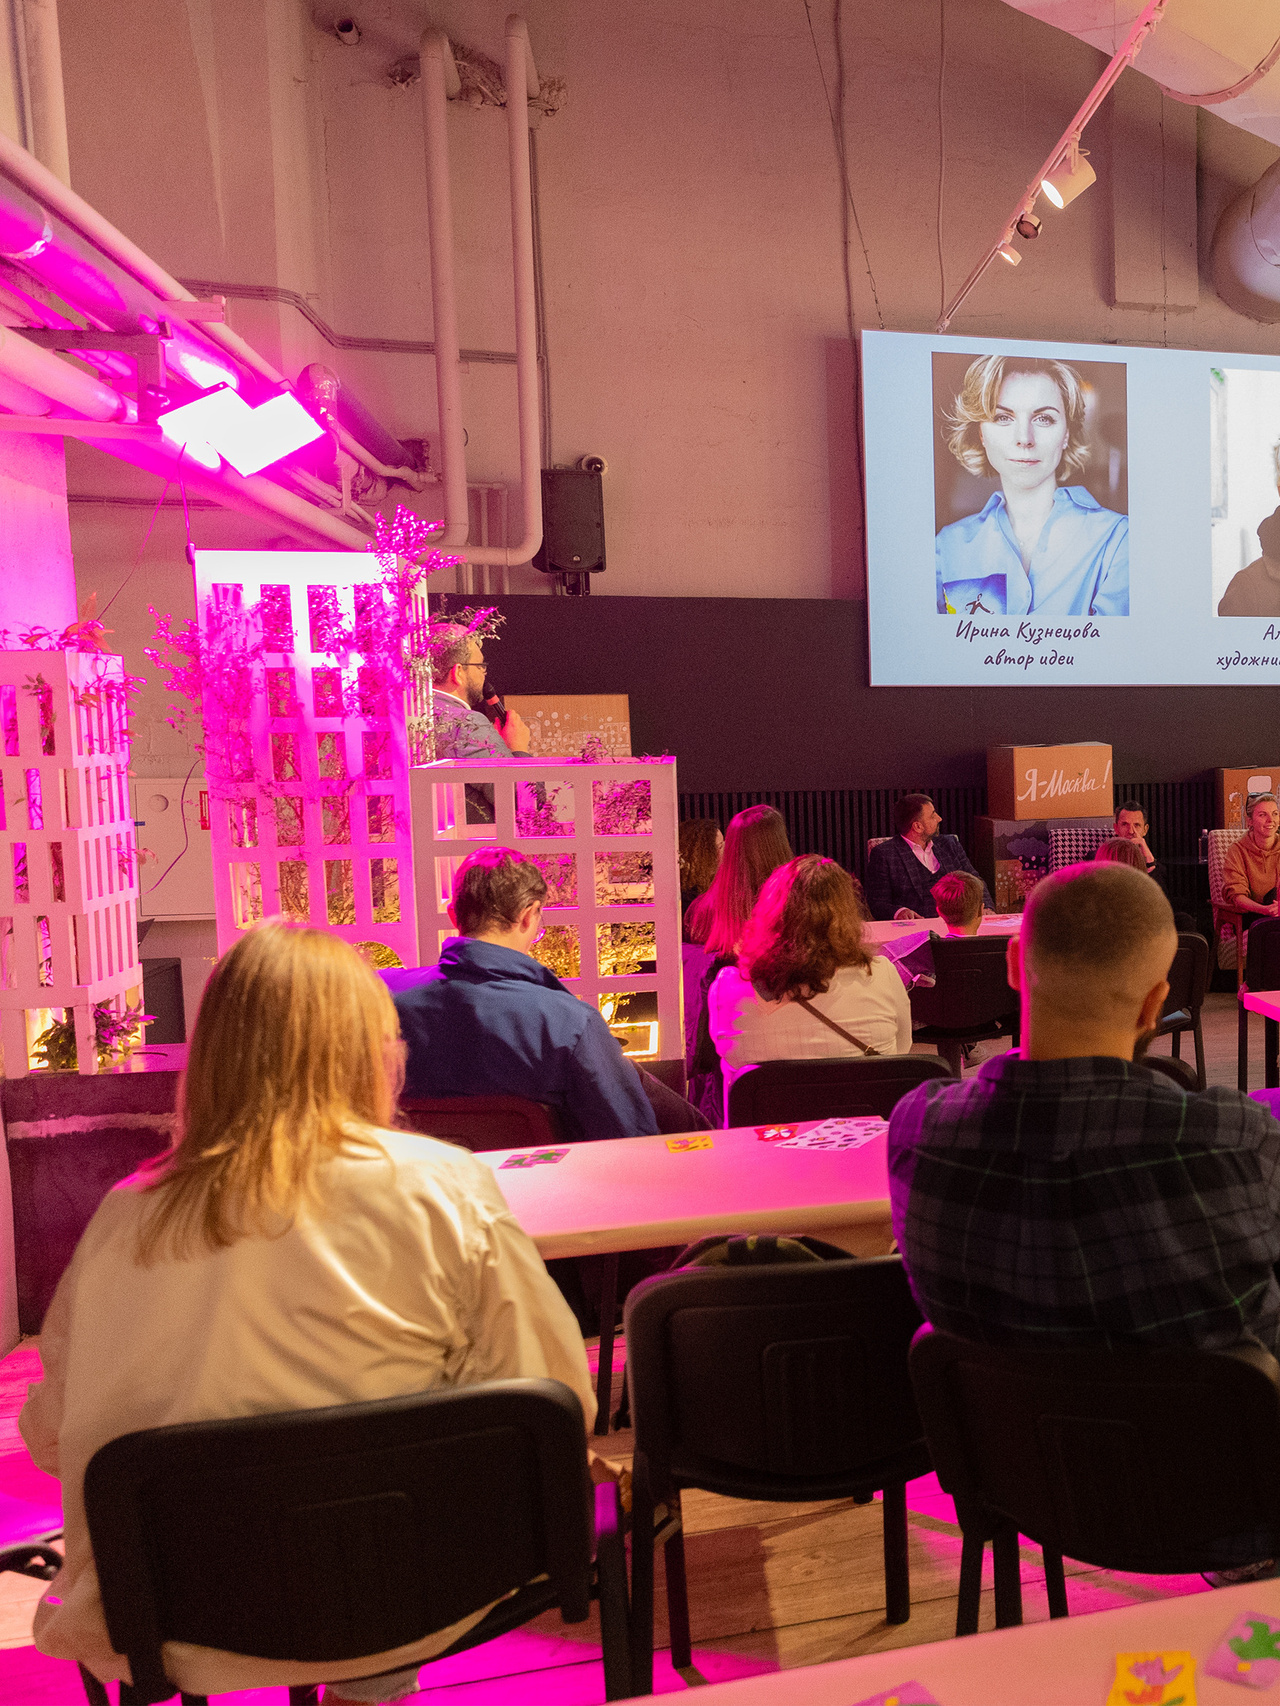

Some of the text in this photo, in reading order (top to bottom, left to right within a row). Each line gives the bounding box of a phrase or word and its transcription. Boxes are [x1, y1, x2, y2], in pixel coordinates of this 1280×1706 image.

[955, 619, 1101, 645] Ирина Кузнецова
[983, 648, 1075, 670] автор идеи
